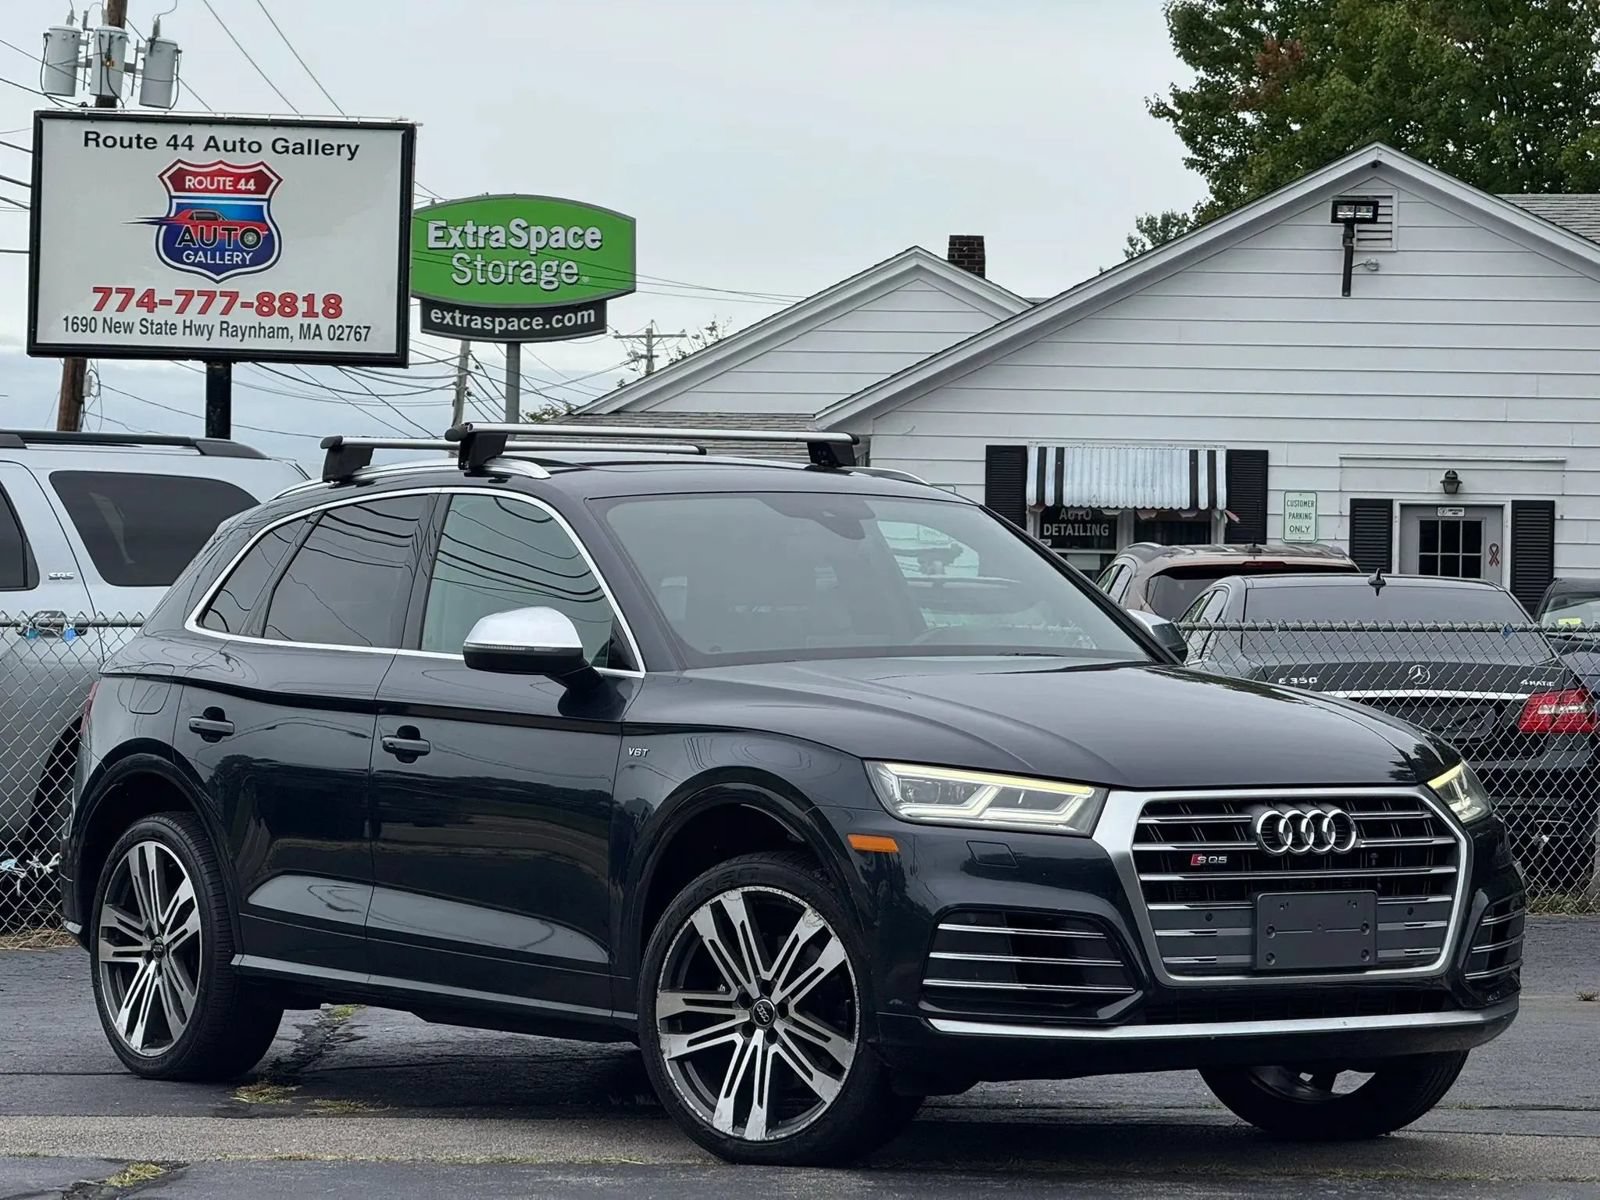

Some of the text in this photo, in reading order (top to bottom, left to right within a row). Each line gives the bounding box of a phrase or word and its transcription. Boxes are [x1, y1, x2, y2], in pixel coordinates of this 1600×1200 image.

[83, 130, 360, 161] Route 44 Auto Gallery
[185, 176, 256, 191] ROUTE 44
[175, 225, 263, 250] AUTO
[427, 218, 603, 255] ExtraSpace
[182, 250, 253, 265] GALLERY
[451, 253, 580, 291] Storage
[92, 286, 343, 320] 774-777-8818
[430, 307, 596, 334] extraspace.com
[63, 315, 371, 342] 1690 New State Hwy Raynham, MA 02767
[1287, 499, 1315, 508] CUSTOMER
[1059, 507, 1093, 521] AUTO
[1288, 511, 1313, 520] PARKING
[1043, 523, 1110, 537] DETAILING
[1289, 524, 1311, 533] ONLY
[628, 747, 649, 757] V6T
